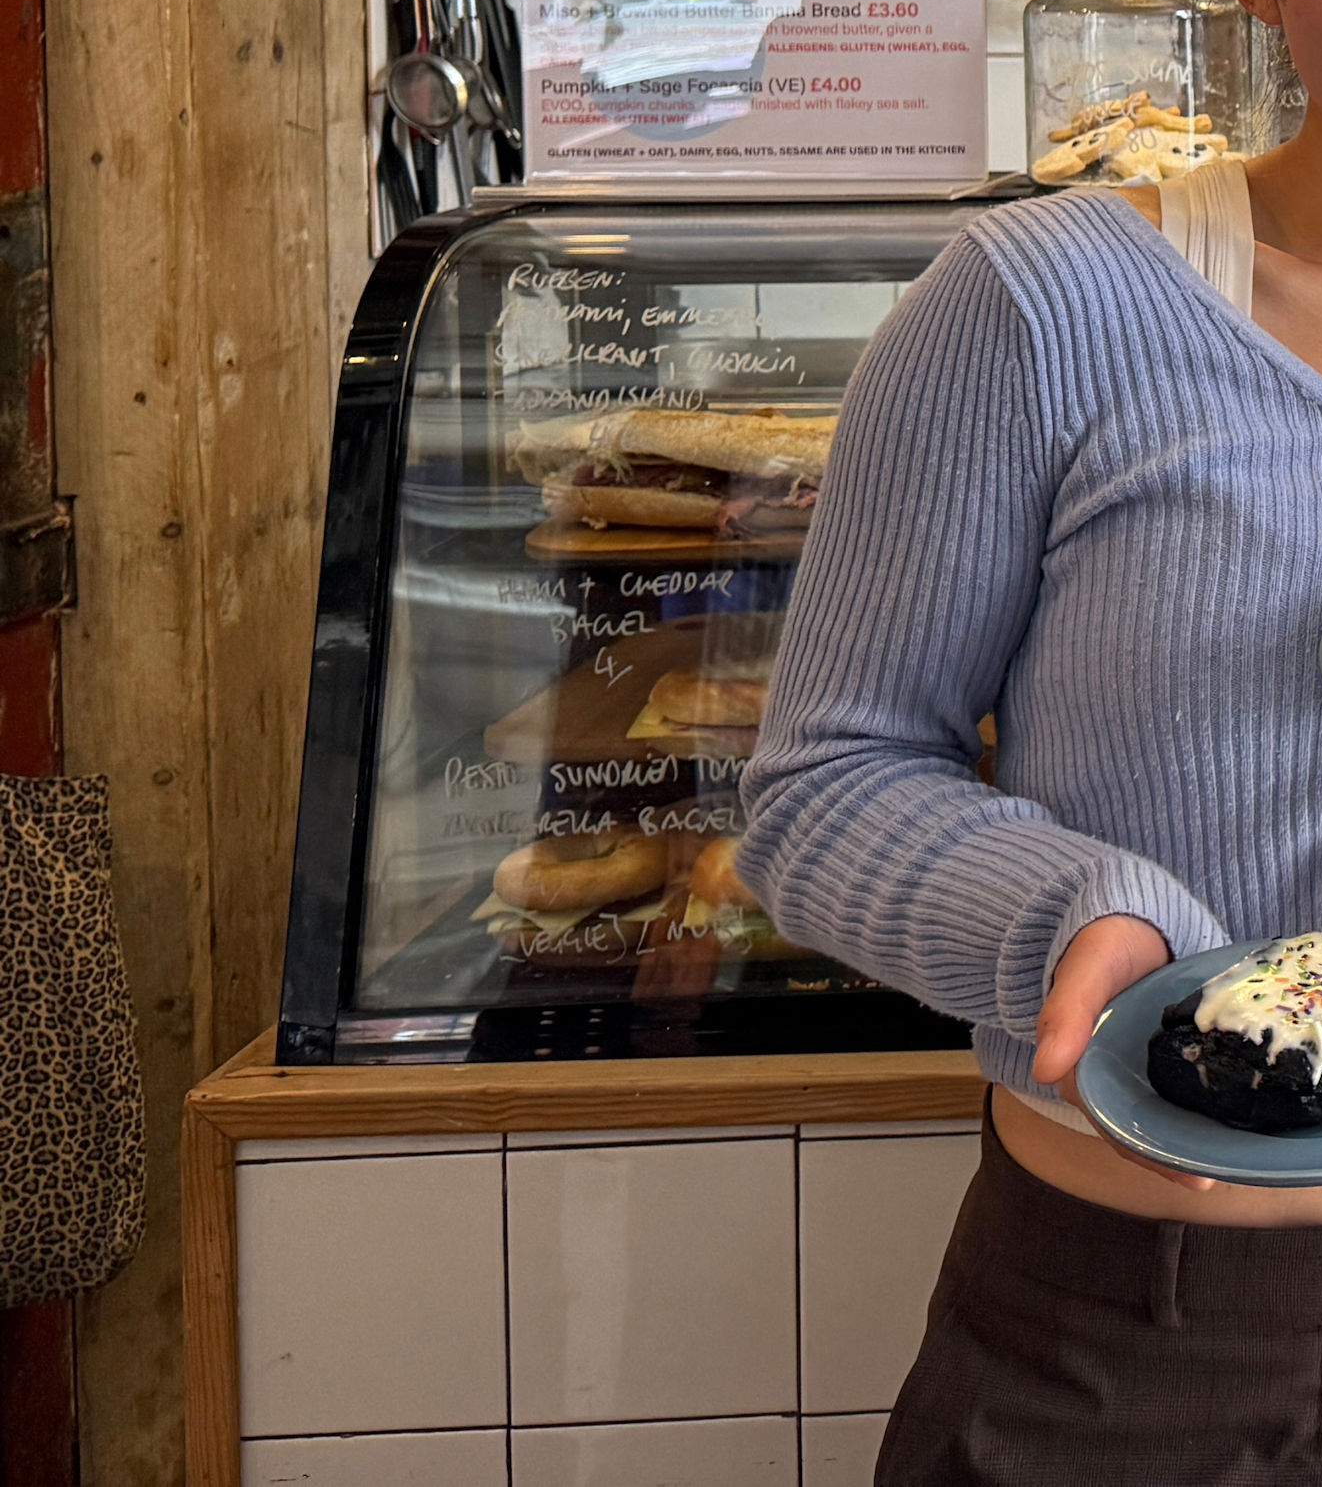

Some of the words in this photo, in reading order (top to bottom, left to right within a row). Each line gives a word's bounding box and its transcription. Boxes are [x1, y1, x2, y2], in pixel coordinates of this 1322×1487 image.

[812, 3, 861, 18] Bread
[868, 2, 919, 18] £3.60
[840, 43, 885, 52] GLUTEN
[640, 79, 682, 97] Sage
[768, 77, 806, 96] (VE)
[810, 77, 861, 93] £4.00
[547, 148, 591, 157] GLUTEN
[779, 146, 824, 156] SESAME
[825, 146, 847, 156] ARE
[849, 146, 878, 156] USED
[881, 146, 893, 155] IN
[895, 145, 916, 155] THE
[918, 145, 966, 155] KITCHEN
[620, 569, 734, 598] CHEDDAR
